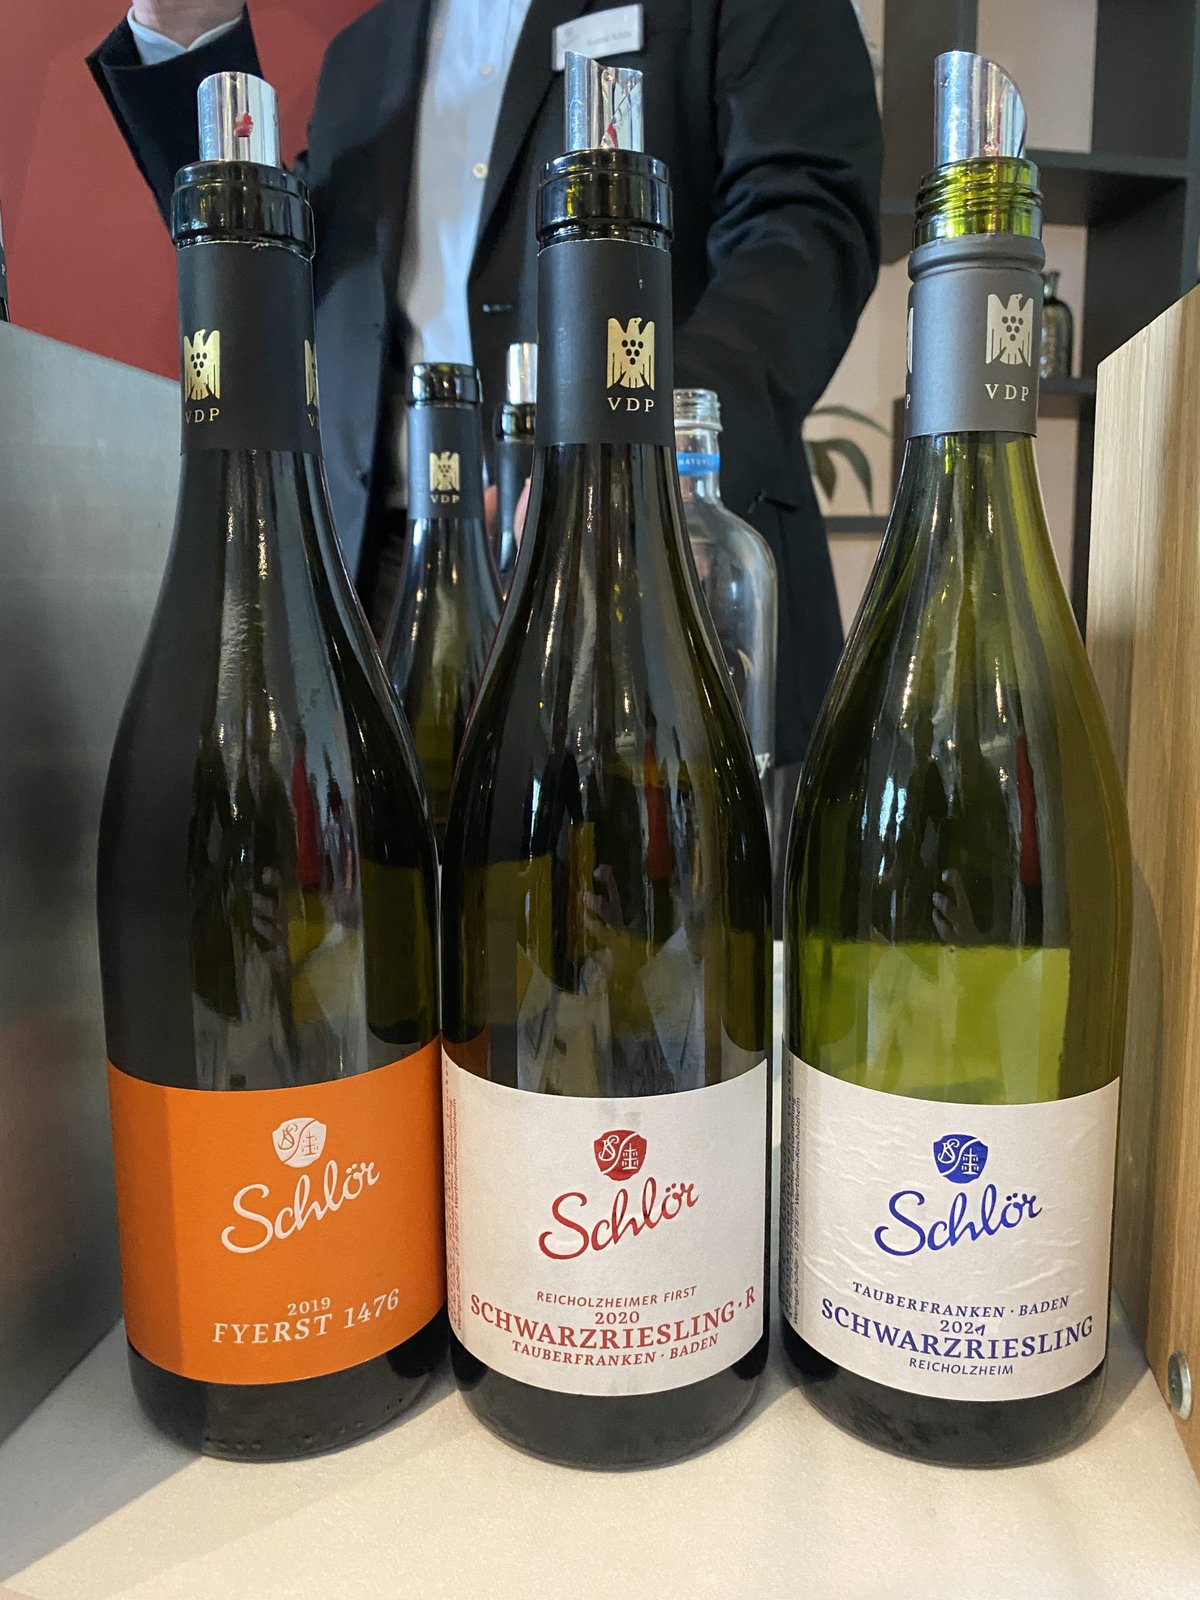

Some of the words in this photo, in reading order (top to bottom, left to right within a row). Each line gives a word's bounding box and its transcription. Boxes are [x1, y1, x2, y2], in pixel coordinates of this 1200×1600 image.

[985, 383, 1029, 402] VDP
[185, 407, 220, 424] VDP
[607, 397, 655, 413] VDP
[430, 494, 460, 504] VDP
[220, 1159, 381, 1254] Schlör
[538, 1176, 700, 1260] Schlör
[874, 1183, 1043, 1257] Schlör
[287, 1296, 331, 1317] 2019
[536, 1290, 658, 1308] REICHOLZHEIMER
[663, 1285, 698, 1303] FIRST
[852, 1281, 1006, 1318] TAUBERFRANKEN
[1018, 1294, 1071, 1317] BADEN
[212, 1313, 333, 1345] FYERST
[343, 1287, 400, 1329] 1476
[594, 1311, 640, 1325] 2020
[821, 1297, 1093, 1360] SCHWARZRIESLING
[511, 1339, 656, 1367] TAUBERFRANKEN
[668, 1332, 719, 1360] BADEN
[908, 1356, 1014, 1376] REICHOLZHEIM
